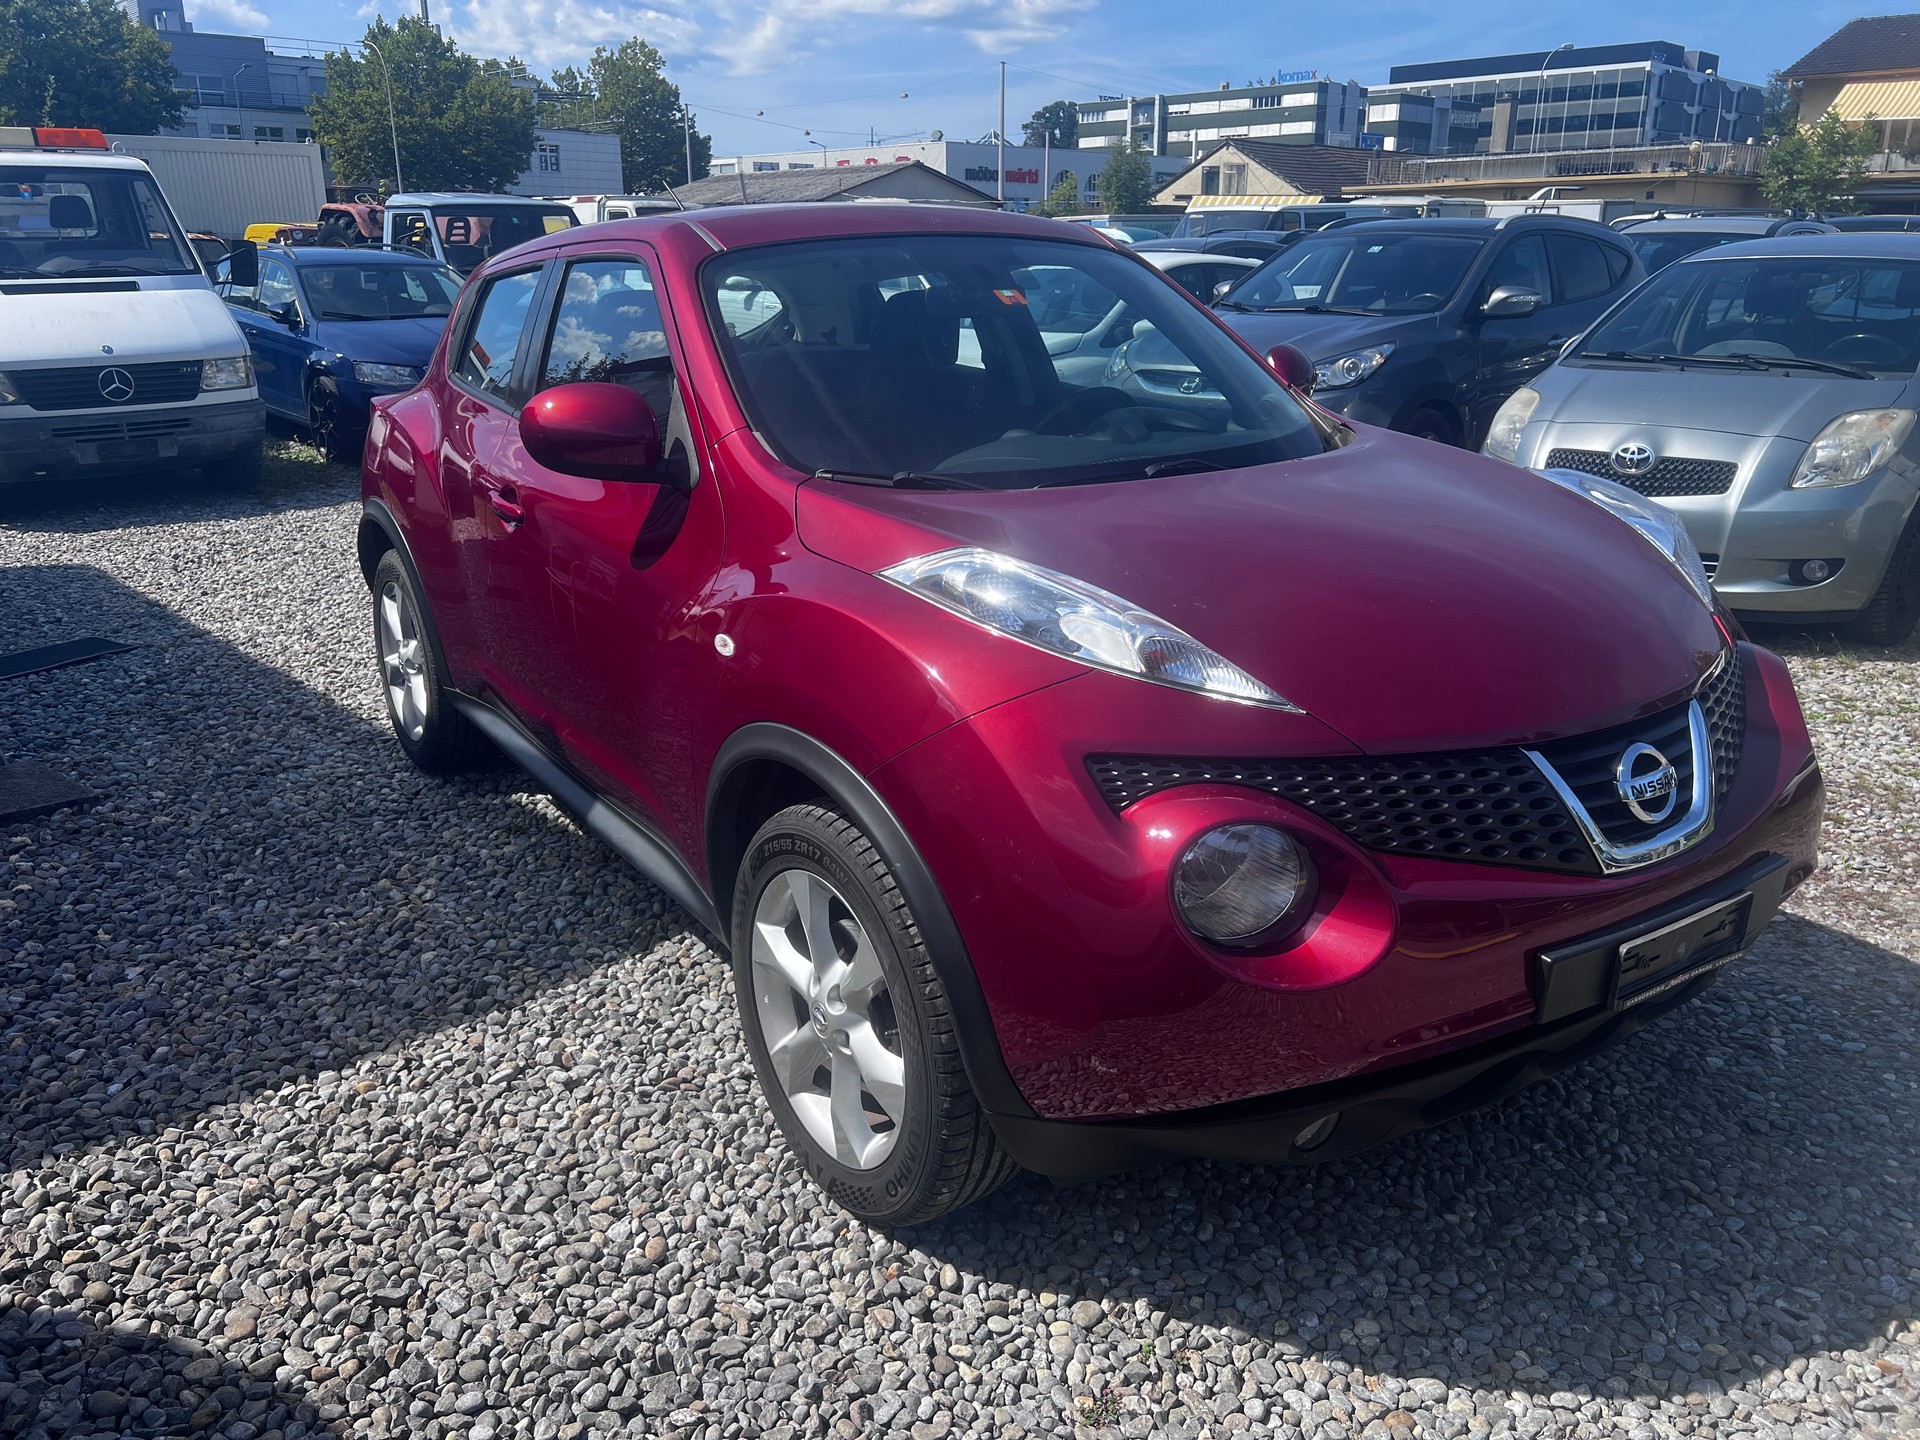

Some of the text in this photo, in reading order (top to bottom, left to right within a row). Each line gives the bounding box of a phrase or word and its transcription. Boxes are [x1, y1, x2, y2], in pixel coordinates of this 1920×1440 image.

[1278, 69, 1318, 83] komax
[965, 166, 1039, 184] möbe märki
[1631, 768, 1677, 796] NISSAN
[763, 838, 792, 857] 215/55
[794, 839, 823, 860] ZR17
[1690, 963, 1713, 977] GARAGE
[885, 1106, 924, 1198] KUMHO
